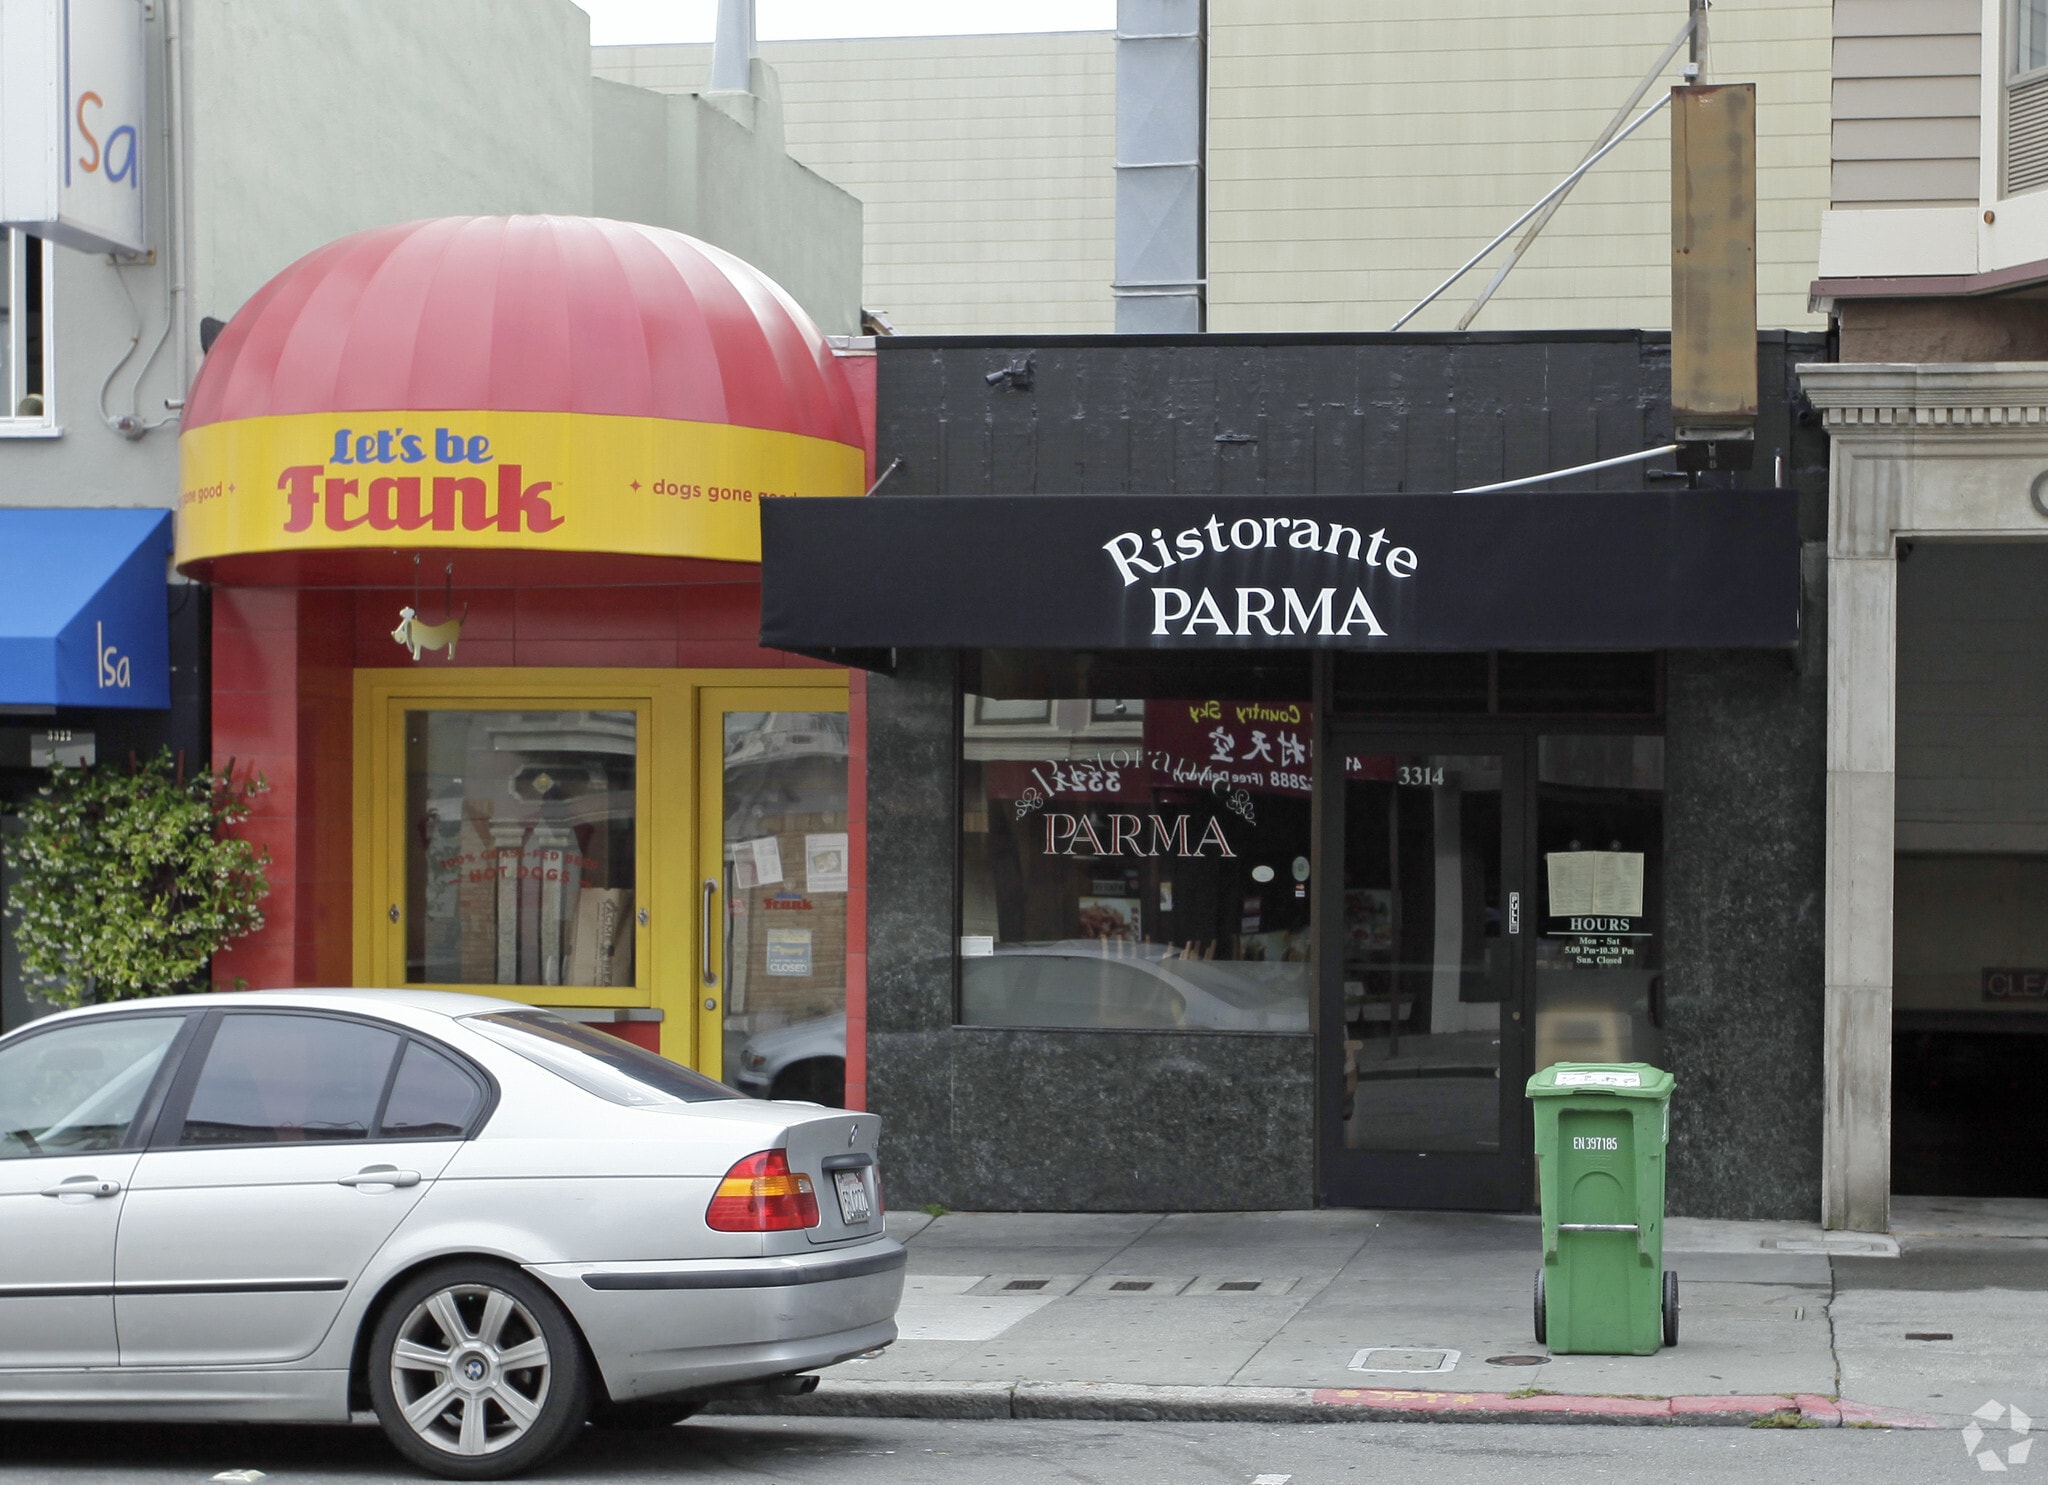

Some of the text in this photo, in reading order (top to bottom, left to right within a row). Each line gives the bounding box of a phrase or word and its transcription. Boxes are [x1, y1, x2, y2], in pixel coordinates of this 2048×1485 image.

[329, 427, 494, 465] Let's be
[199, 481, 223, 505] good
[277, 464, 565, 534] Frank
[652, 478, 753, 502] dogs gone
[1102, 513, 1418, 587] Ristorante
[1150, 586, 1389, 637] PARMA
[96, 620, 131, 689] Isa
[1397, 766, 1445, 786] 3314
[1042, 813, 1237, 858] PARMA
[468, 866, 571, 885] HOT DOGS
[1569, 917, 1631, 932] HOURS
[1564, 946, 1581, 955] 5.00
[1621, 947, 1635, 956] Pm
[1579, 936, 1597, 945] Mon
[1606, 936, 1620, 945] Sat
[769, 963, 808, 974] CLOSED
[1576, 955, 1623, 965] Sun. Closed
